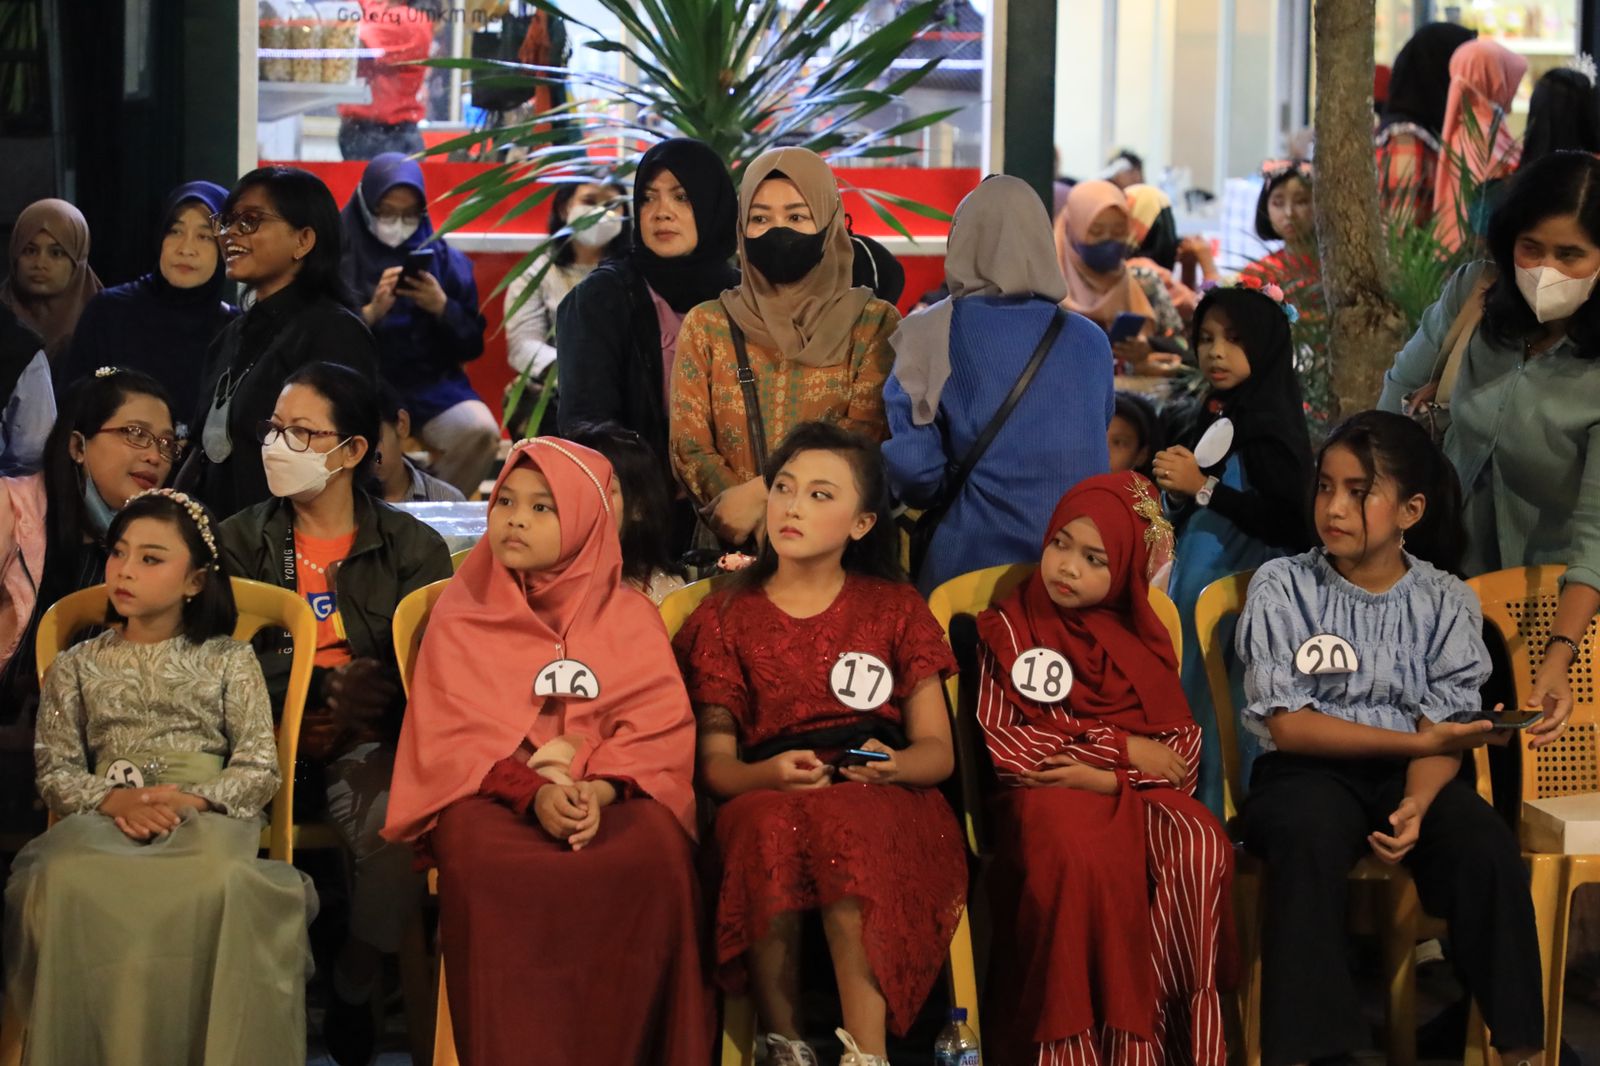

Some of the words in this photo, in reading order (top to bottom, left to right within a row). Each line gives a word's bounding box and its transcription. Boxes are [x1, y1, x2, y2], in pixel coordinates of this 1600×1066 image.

[283, 548, 295, 580] YOUNG
[312, 596, 332, 619] G
[1306, 643, 1349, 674] 20
[544, 670, 589, 697] 16
[838, 659, 886, 703] 17
[1019, 656, 1064, 697] 18
